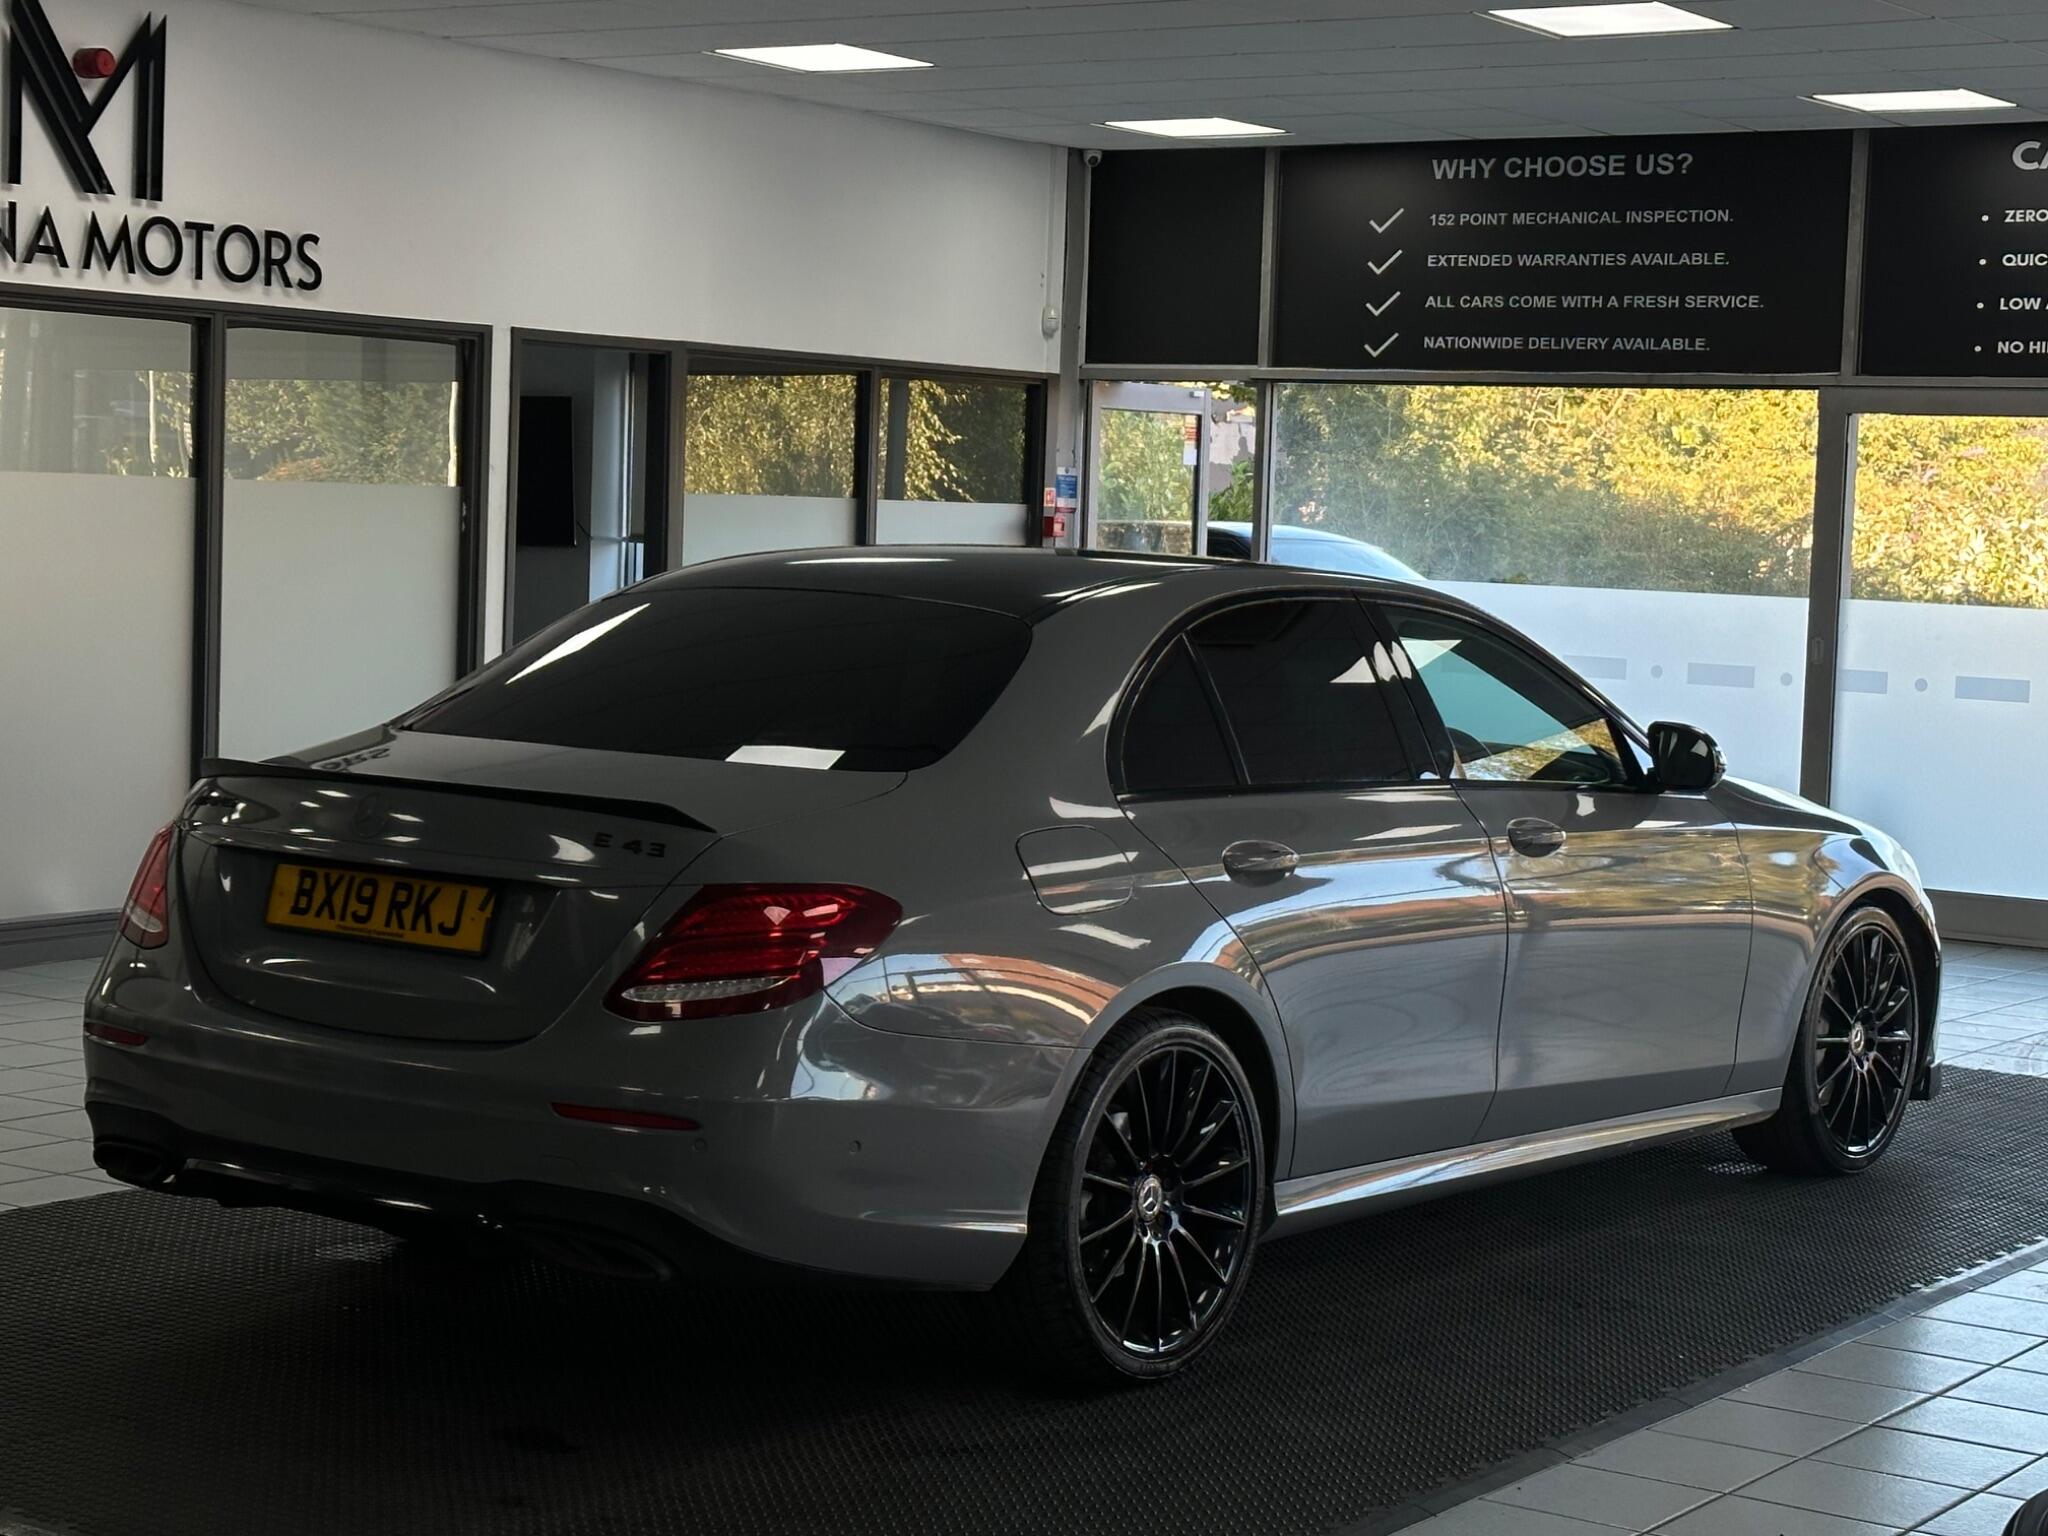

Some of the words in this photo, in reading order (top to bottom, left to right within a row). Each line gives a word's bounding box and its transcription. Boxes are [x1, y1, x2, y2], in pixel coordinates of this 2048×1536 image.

[1431, 158, 1497, 180] WHY
[1503, 155, 1626, 179] CHOOSE
[1636, 153, 1693, 176] US?
[1429, 213, 1456, 227] 152
[1459, 212, 1508, 226] POINT
[1512, 211, 1621, 225] MECHANICAL
[1626, 209, 1734, 224] INSPECTION.
[2004, 209, 2048, 223] ZERO
[81, 210, 323, 291] MOTORS
[1427, 254, 1513, 268] EXTENDED
[1517, 253, 1627, 267] WARRANTIES
[1630, 252, 1730, 266] AVAILABLE.
[1424, 295, 1456, 308] ALL
[1459, 295, 1505, 309] CARS
[1508, 295, 1557, 308] COME
[1561, 295, 1603, 308] WITH
[1606, 295, 1619, 308] A
[1623, 295, 1680, 308] FRESH
[1684, 295, 1764, 309] SERVICE.
[1999, 297, 2042, 311] LOW
[1423, 336, 1524, 350] NATIONWIDE
[1528, 336, 1609, 350] DELIVERY
[1611, 337, 1710, 351] AVAILABLE.
[1997, 340, 2025, 354] NO
[2028, 340, 2048, 354] HI
[592, 831, 613, 848] E
[621, 839, 667, 858] 43
[289, 869, 380, 925] BX19
[383, 881, 469, 937] RKJ
